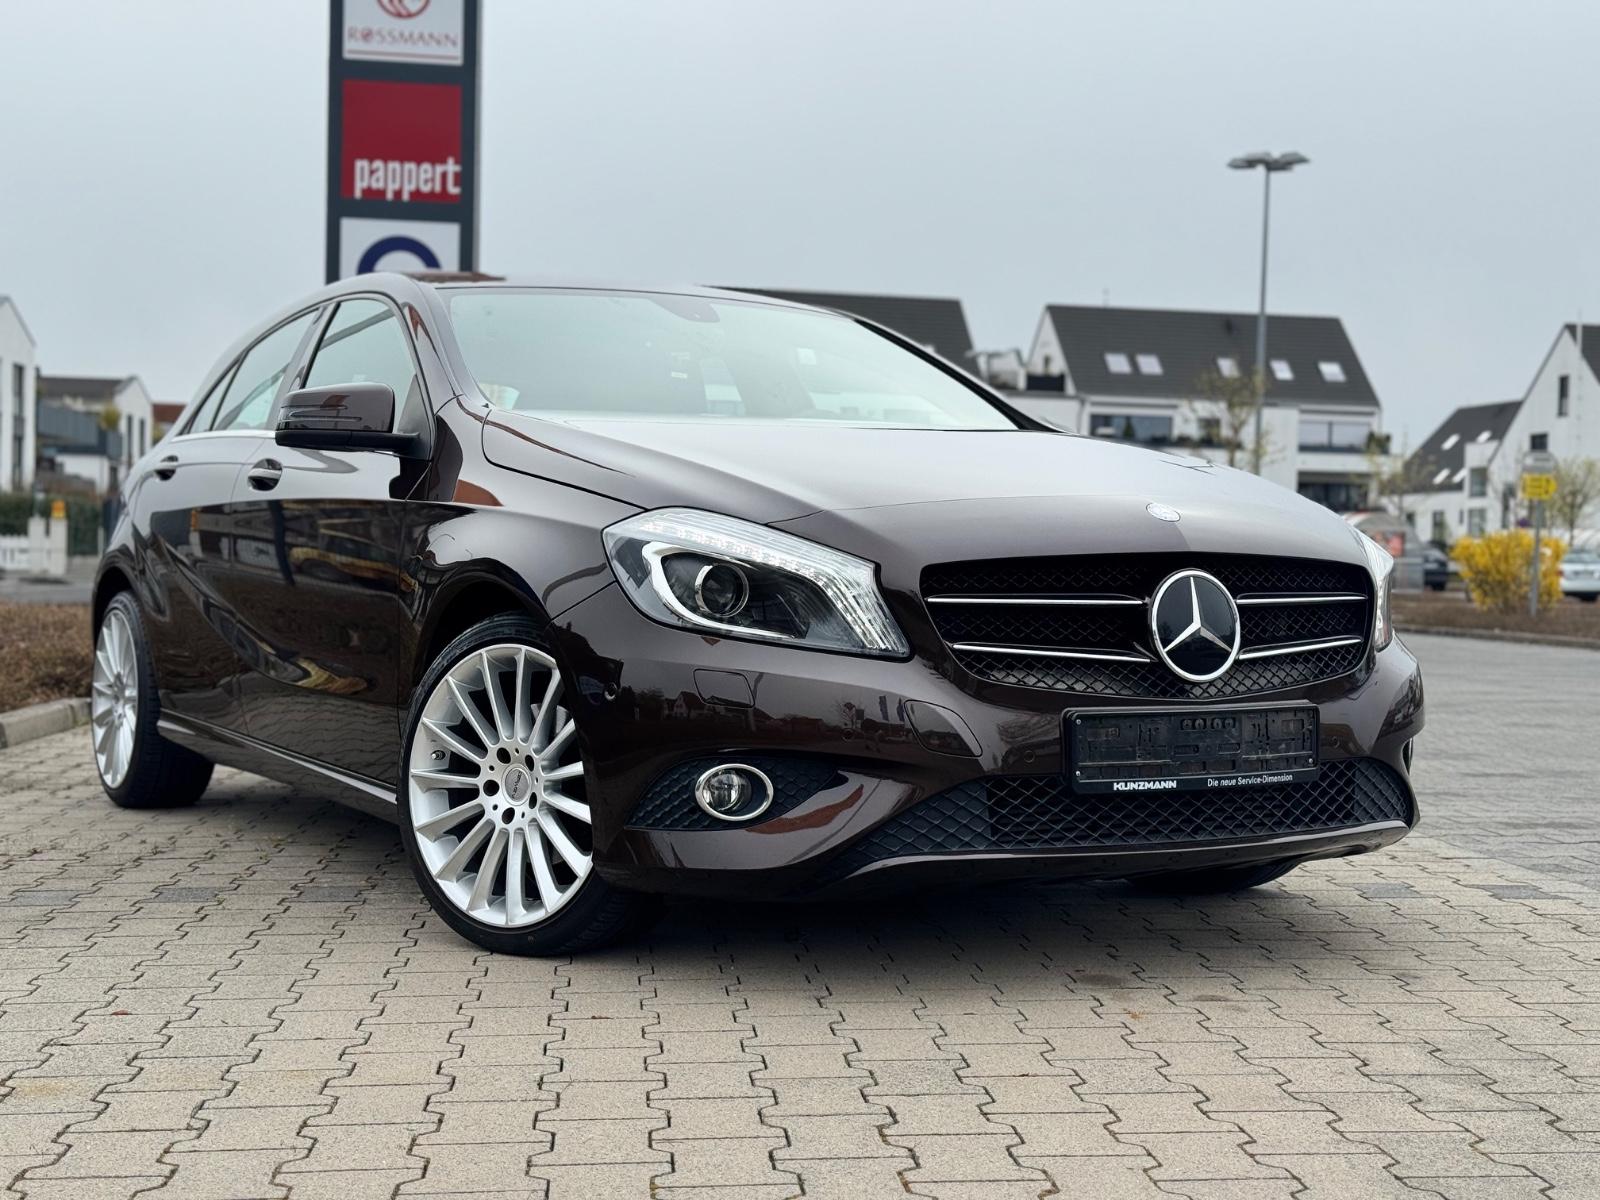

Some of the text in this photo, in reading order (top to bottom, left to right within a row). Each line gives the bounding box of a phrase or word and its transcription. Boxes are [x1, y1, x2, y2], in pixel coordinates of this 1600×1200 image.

[347, 26, 458, 48] ROSSMANN
[354, 156, 462, 202] pappert
[1113, 780, 1177, 791] KUNZMANN
[1207, 778, 1219, 787] Die
[1237, 774, 1293, 785] Service-Dimension
